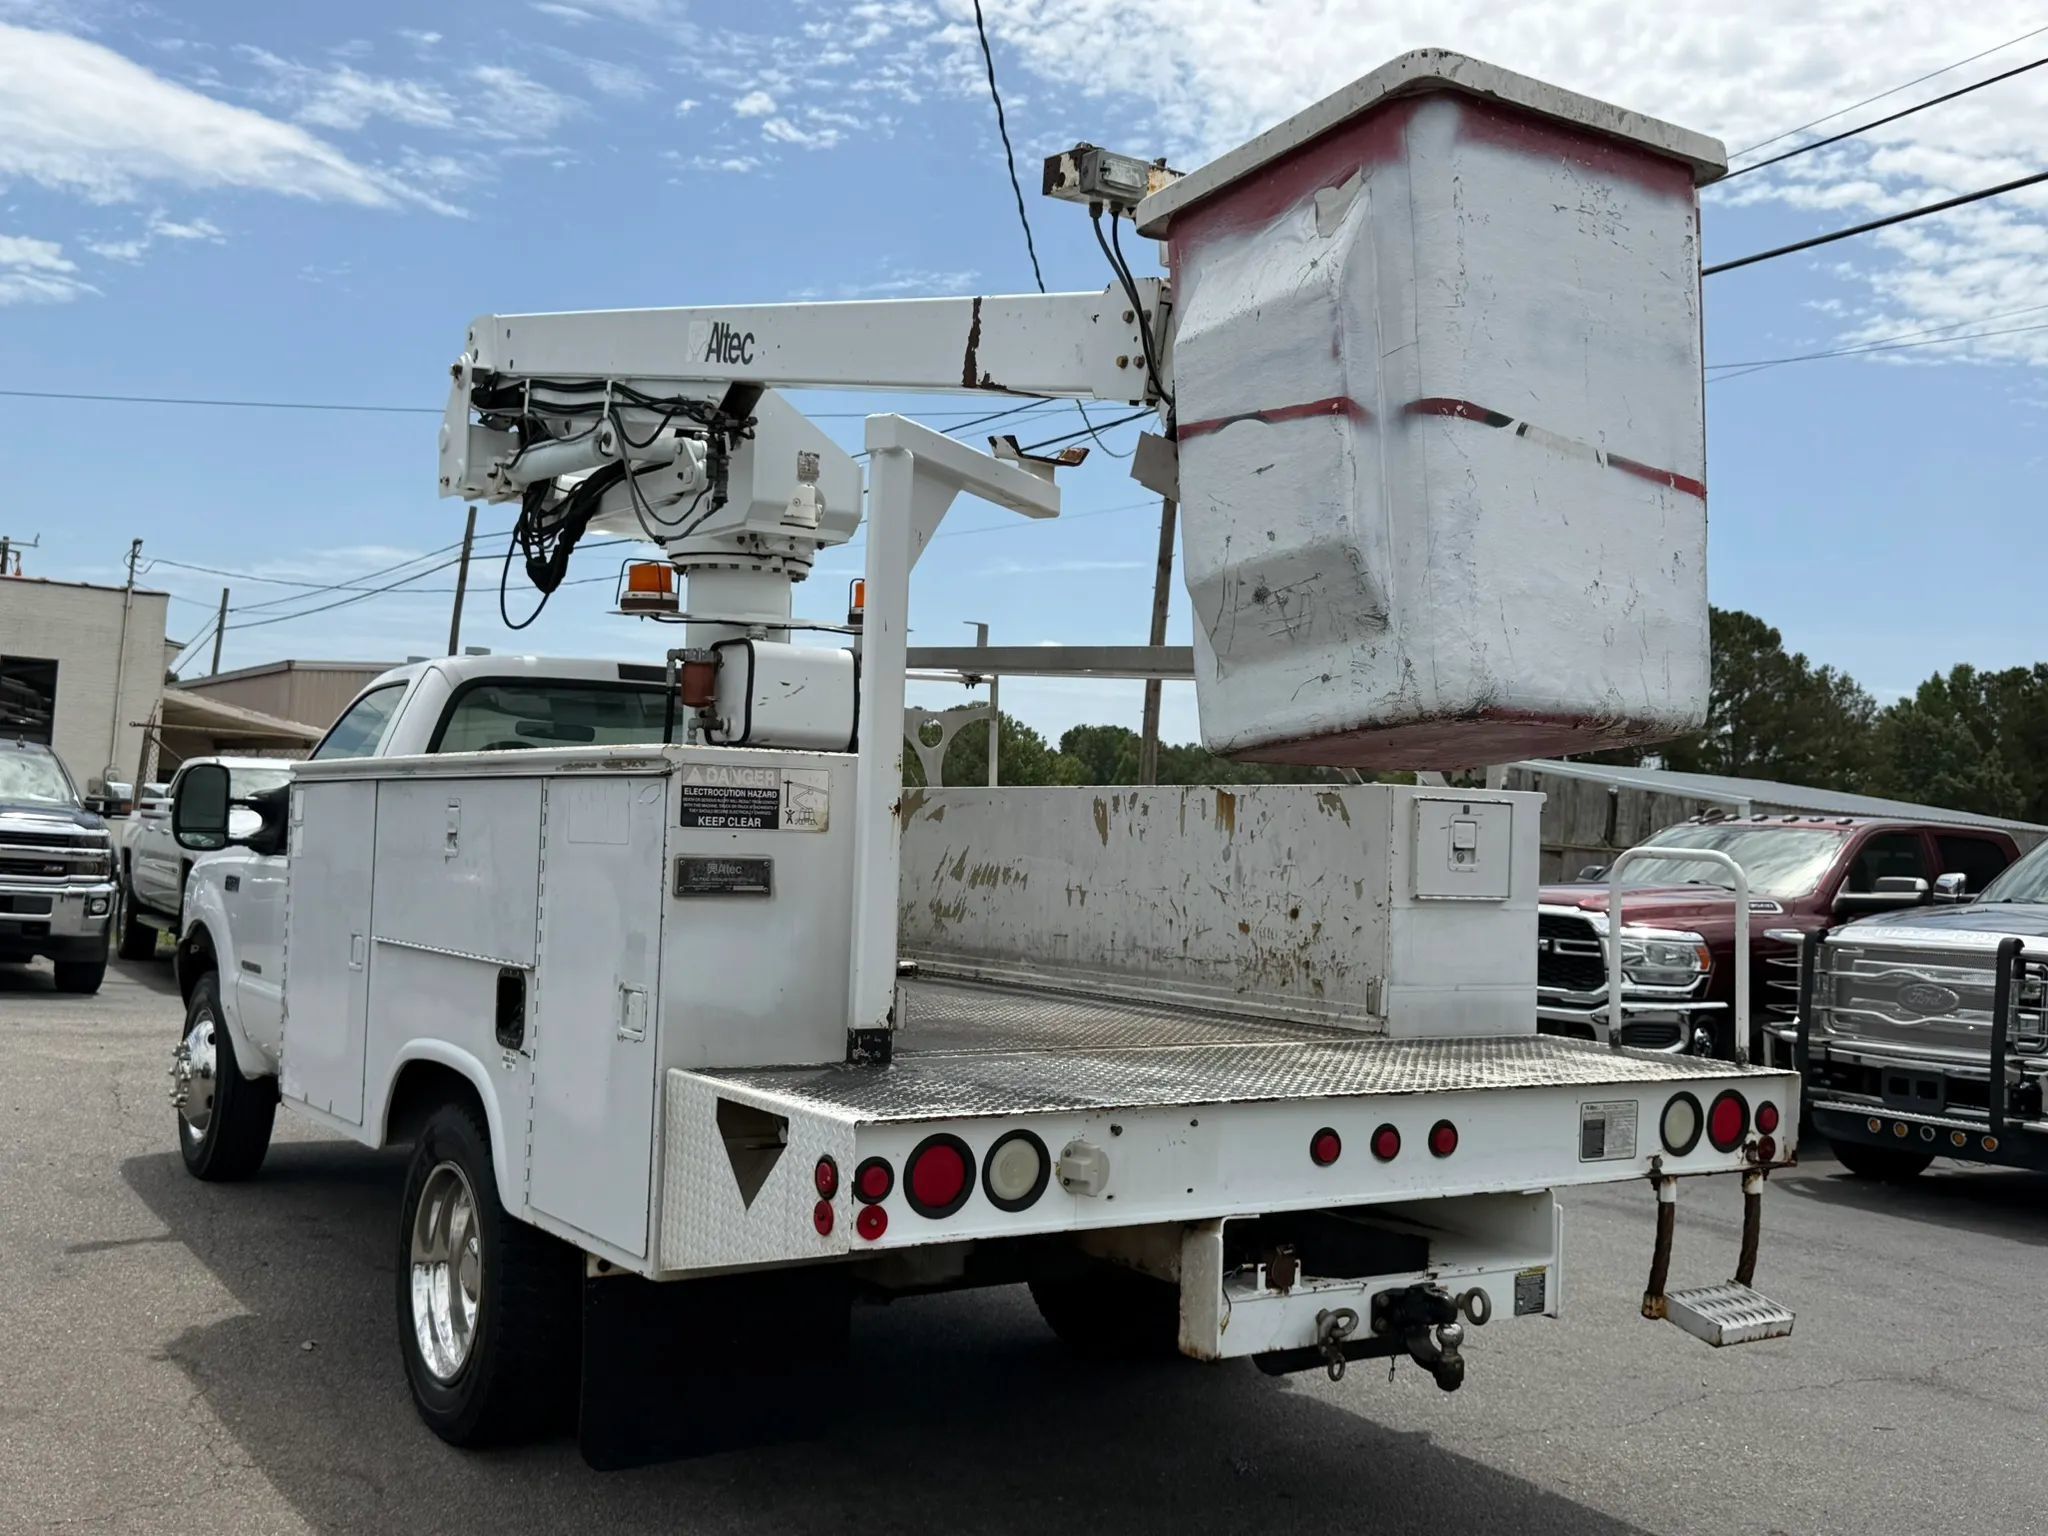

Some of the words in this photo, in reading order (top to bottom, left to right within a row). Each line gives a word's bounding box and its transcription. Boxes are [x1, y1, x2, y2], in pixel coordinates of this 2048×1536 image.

[705, 322, 755, 365] Altec
[706, 768, 775, 787] DANGER
[684, 788, 746, 798] ELECTROCUTION
[747, 790, 777, 799] HAZARD
[697, 816, 726, 827] KEEP
[727, 817, 762, 828] CLEAR
[718, 864, 742, 874] Altec
